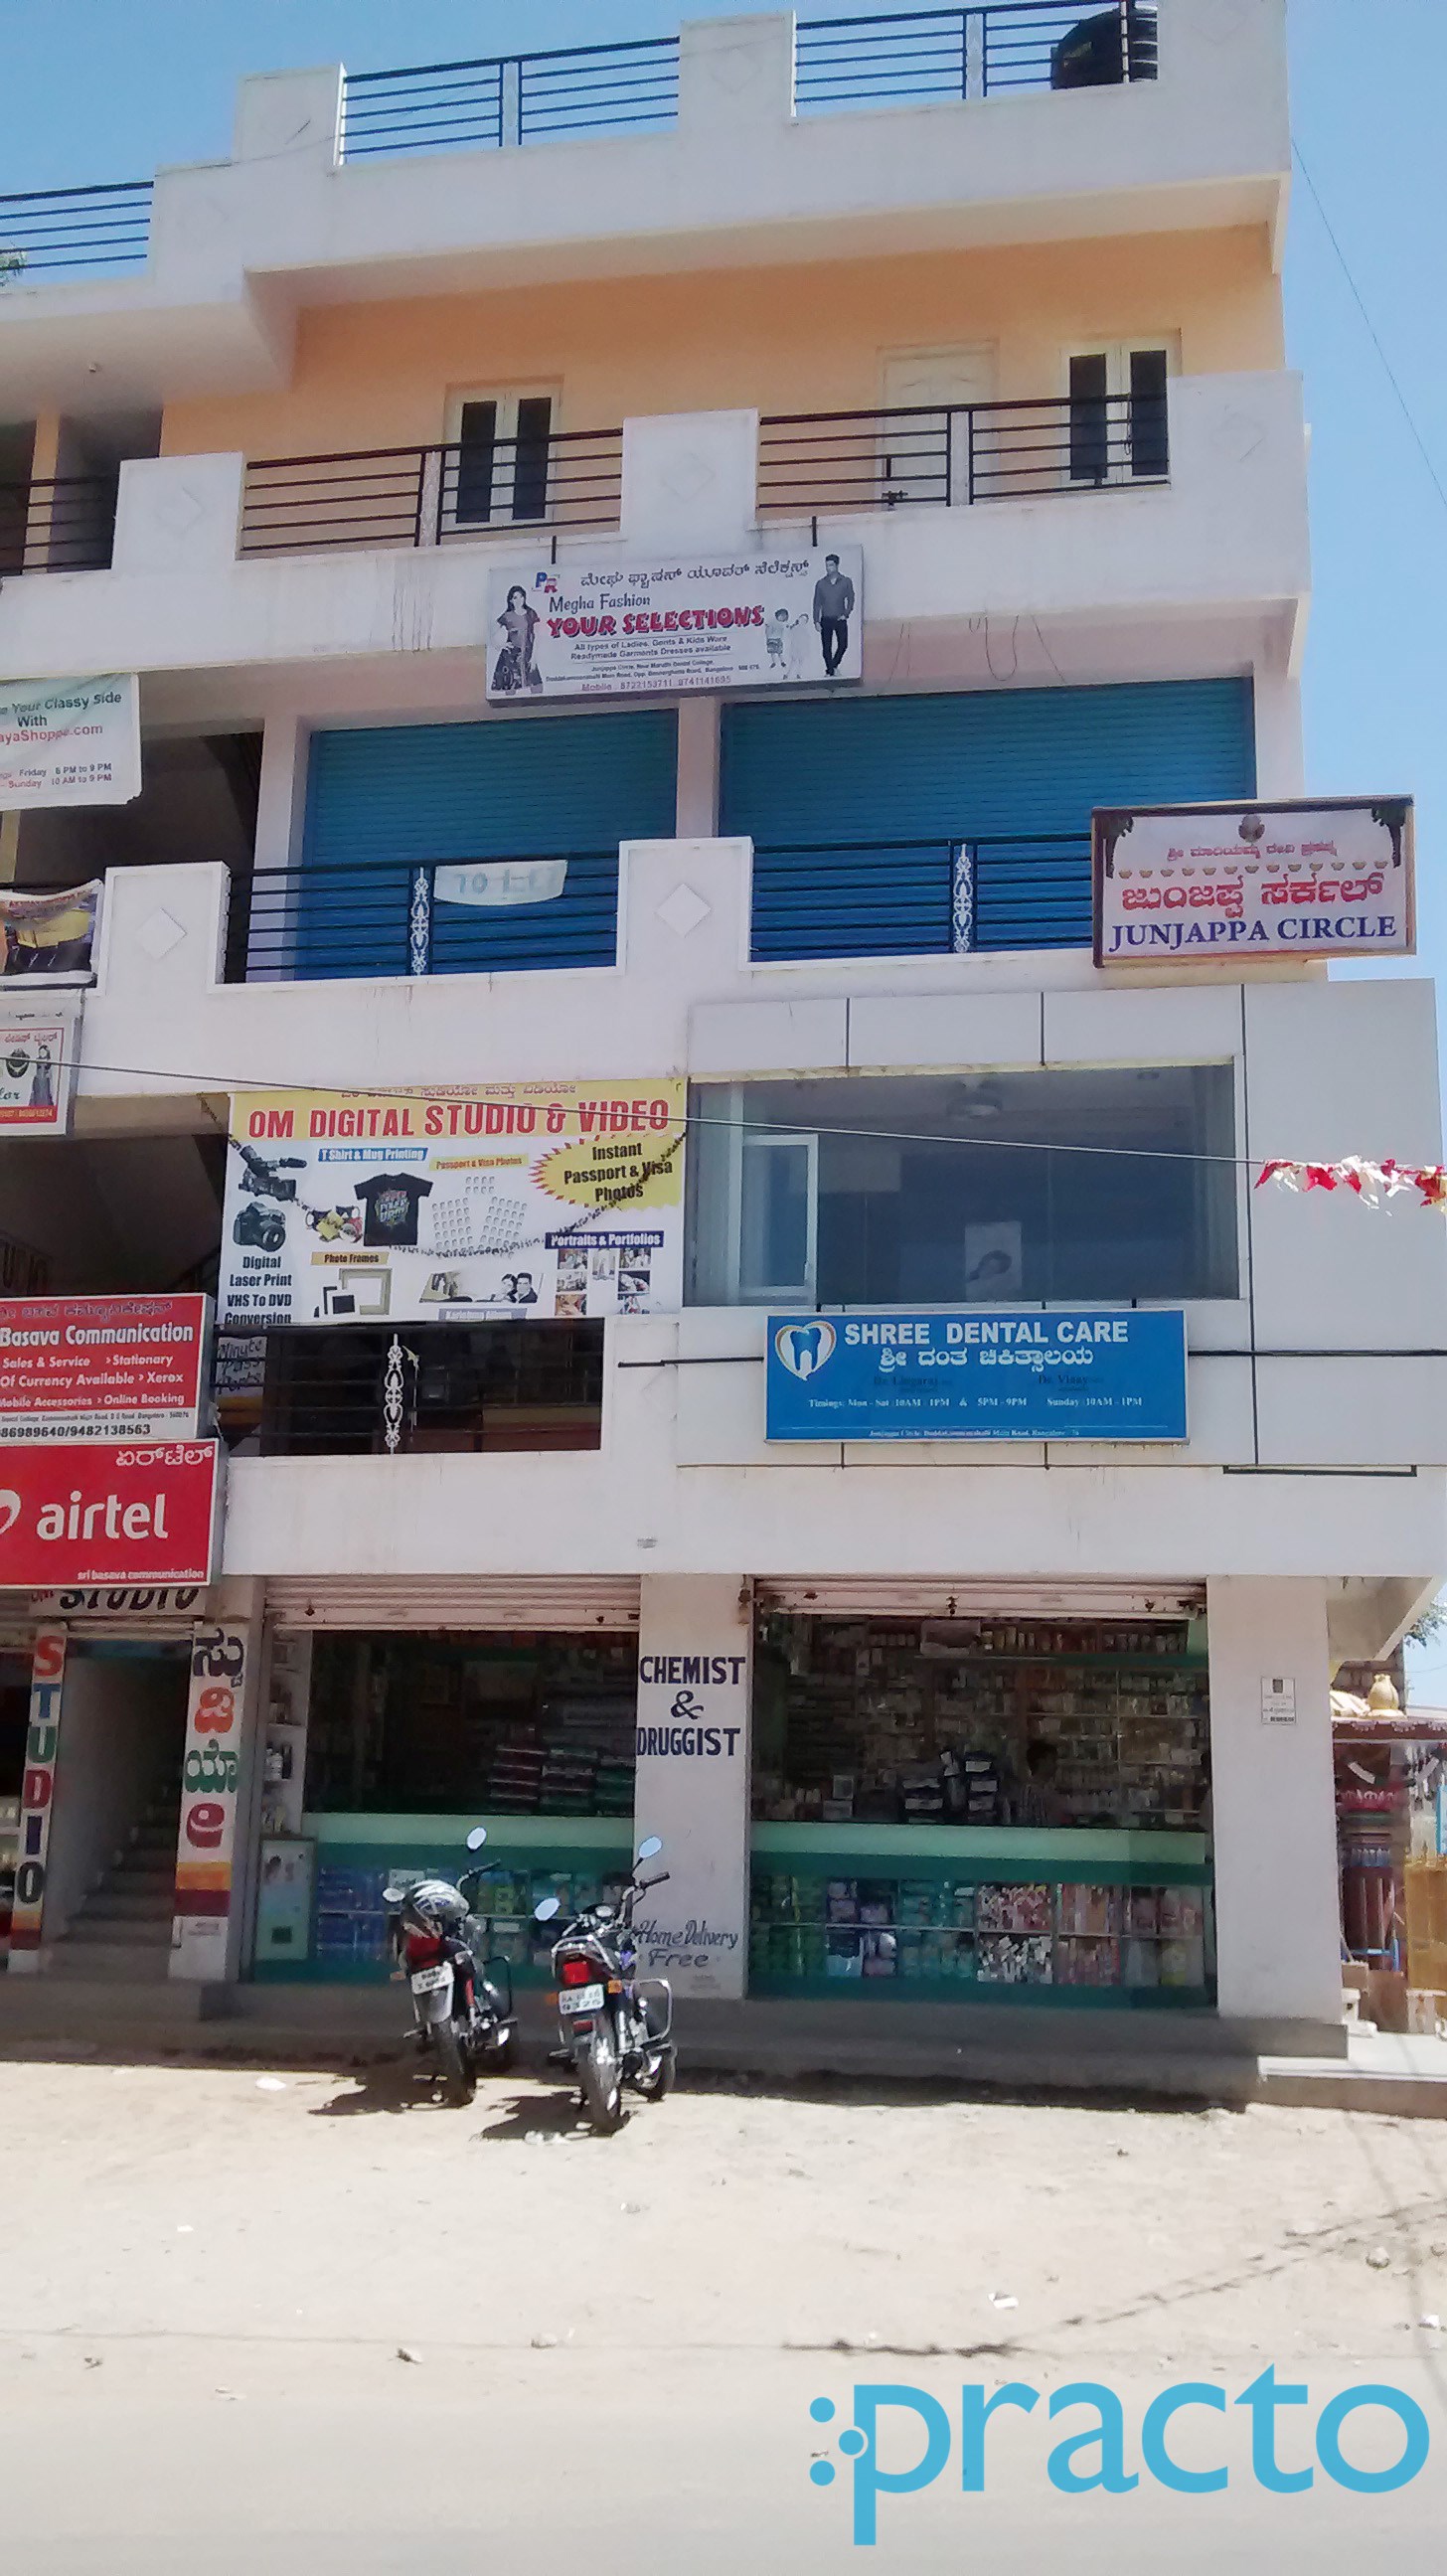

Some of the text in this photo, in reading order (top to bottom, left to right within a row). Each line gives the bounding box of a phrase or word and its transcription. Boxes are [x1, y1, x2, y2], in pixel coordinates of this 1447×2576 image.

[549, 592, 651, 614] Megha Fashion
[547, 604, 765, 638] YOUR SELECTIONS
[570, 644, 731, 661] Readymade Garments Dresses available
[12, 703, 41, 714] Your
[44, 696, 89, 710] Classy
[17, 715, 48, 727] With
[79, 764, 87, 773] to
[97, 762, 112, 771] PM
[8, 779, 42, 788] Sunday
[52, 776, 60, 785] 10
[62, 775, 76, 784] AM
[1122, 872, 1384, 917] ಜುಂಜಪ್ಪ ಸರ್ಕಲ್
[1109, 915, 1397, 952] JUNJAPPA CIRCLE
[248, 1099, 669, 1138] OM DIGITAL STUDIO & VIDEO
[329, 1148, 353, 1160] Shirt
[355, 1149, 361, 1160] &
[363, 1148, 384, 1161] Mug
[385, 1147, 424, 1161] Printing
[592, 1143, 643, 1161] Instant
[563, 1160, 673, 1185] Passport & Visa
[595, 1183, 644, 1203] Photos
[552, 1232, 662, 1247] Portraits & Portfolios
[242, 1255, 281, 1270] Digital
[324, 1253, 380, 1264] Photo Frames
[230, 1273, 292, 1287] Laser Print
[227, 1294, 292, 1307] VHS To DVD
[225, 1312, 291, 1324] Conversion
[0, 1322, 194, 1347] Basava Communication
[845, 1321, 1129, 1345] SHREE DENTAL CARE
[3, 1356, 90, 1369] Sales & Service
[112, 1355, 173, 1368] Stationary
[879, 1346, 1093, 1372] ಶ್ರೀ ದಂತ ಚಿಕಿತ್ಸಾಲಯ
[0, 1372, 134, 1389] Of Currency Available
[147, 1372, 184, 1383] Xerox
[0, 1395, 92, 1407] Mobile Accessories
[103, 1393, 185, 1406] Online Booking
[1046, 1397, 1078, 1407] Sunday
[37, 1491, 169, 1540] airtel
[78, 1567, 205, 1581] sri basava communication
[640, 1656, 746, 1685] CHEMIST
[670, 1690, 705, 1720] &
[636, 1727, 741, 1757] DRUGGIST
[18, 1635, 66, 1904] STUDIO
[637, 1919, 739, 1950] Home Delivery
[648, 1948, 710, 1968] Free
